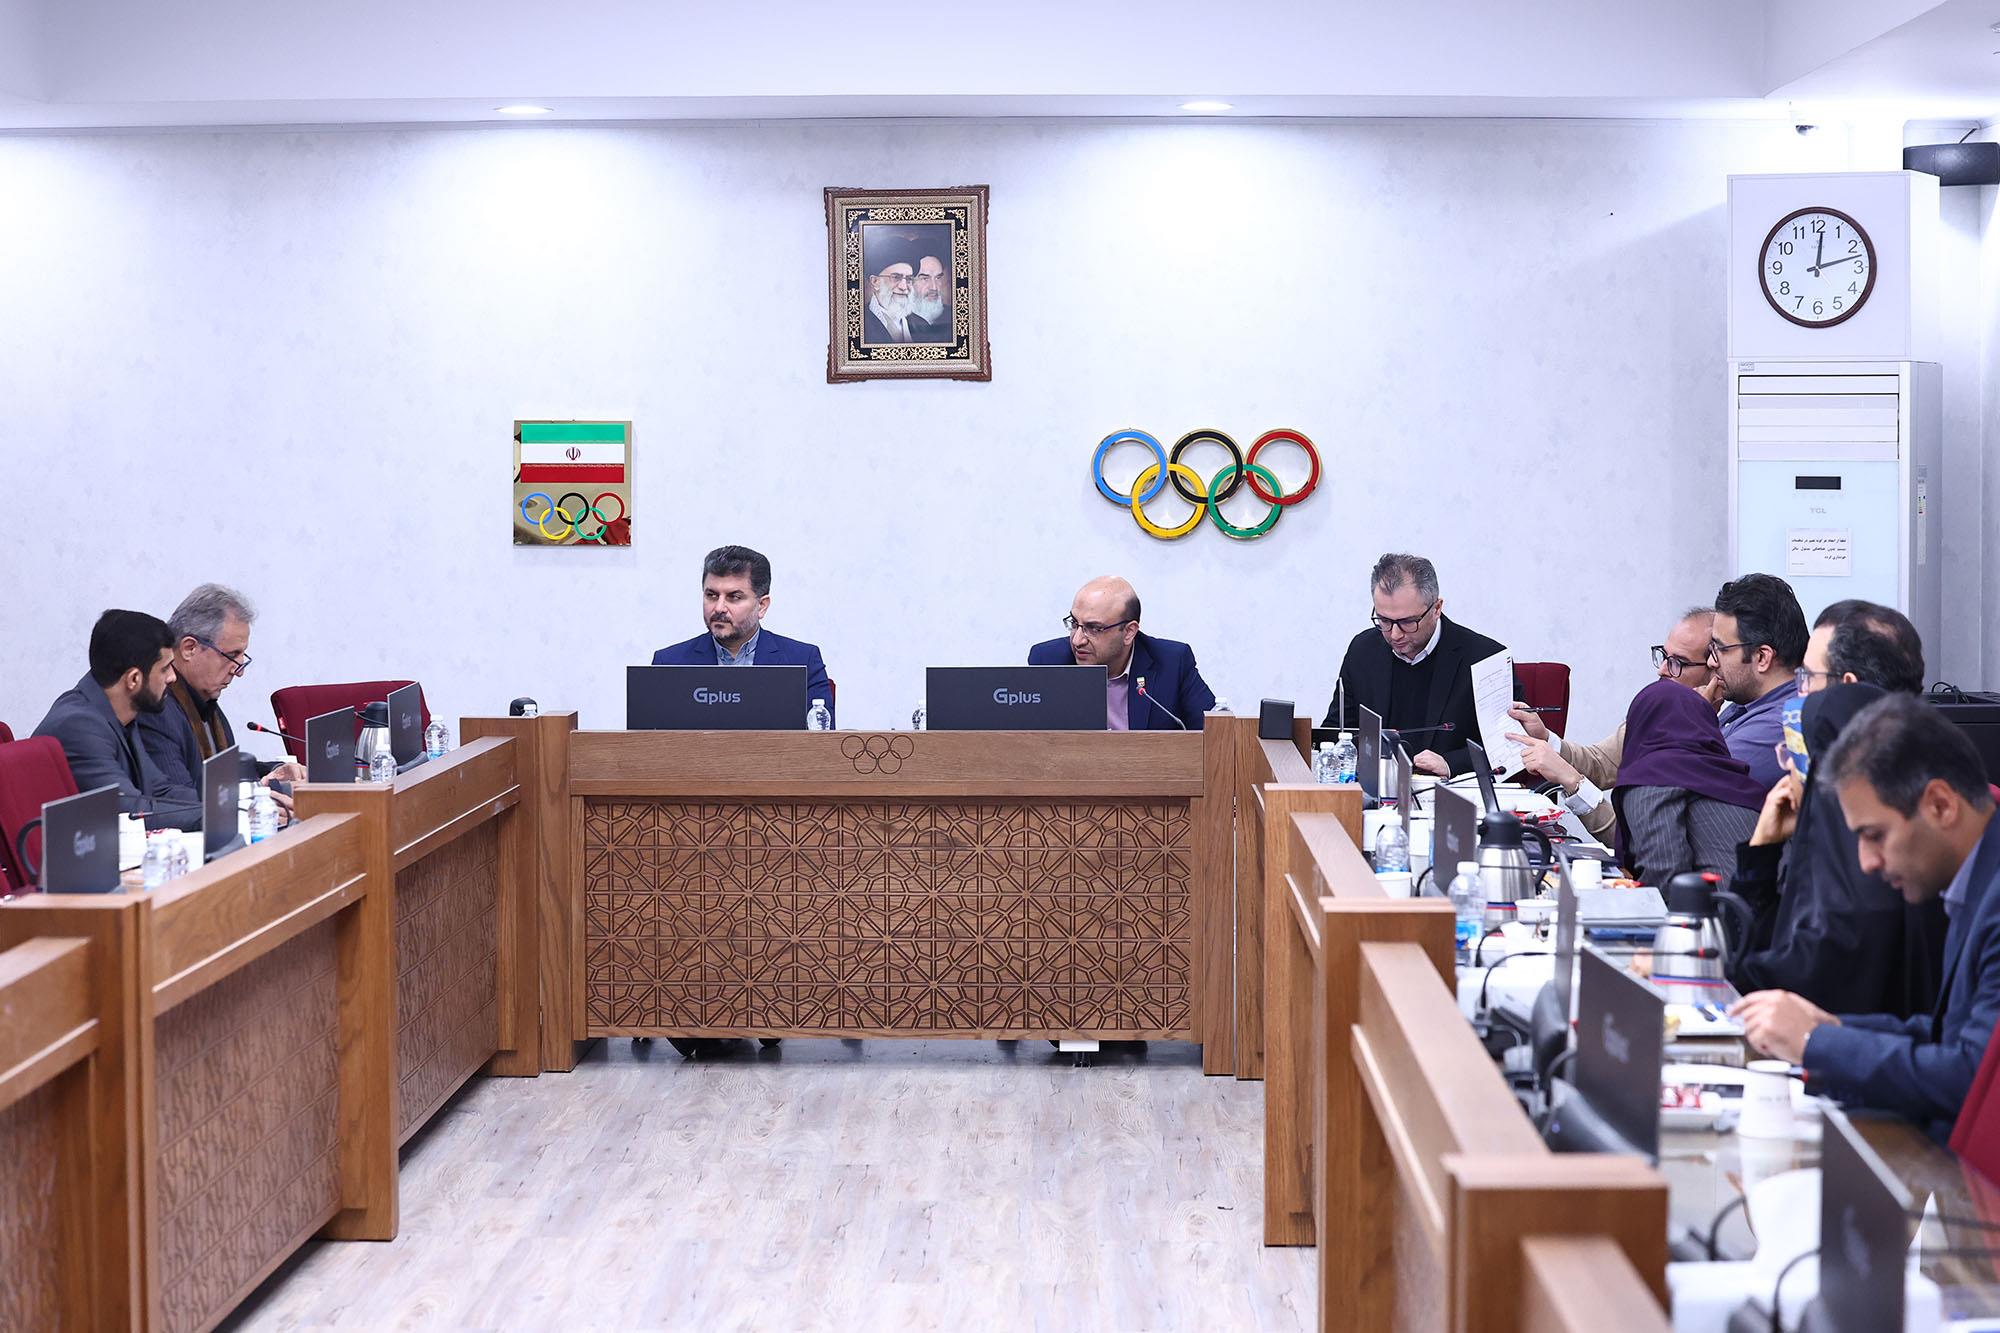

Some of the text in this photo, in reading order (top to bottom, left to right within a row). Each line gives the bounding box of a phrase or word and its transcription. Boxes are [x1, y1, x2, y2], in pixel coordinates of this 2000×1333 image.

[1792, 226, 1805, 239] 11
[1810, 220, 1826, 234] 12
[1836, 225, 1841, 239] 1
[1777, 242, 1793, 255] 10
[1848, 239, 1858, 254] 2
[1772, 261, 1783, 275] 9
[1853, 260, 1864, 274] 3
[1780, 281, 1790, 295] 8
[1847, 281, 1858, 295] 4
[1794, 295, 1804, 309] 7
[1813, 301, 1823, 315] 6
[1832, 297, 1843, 310] 5
[693, 687, 741, 705] Gplus
[993, 687, 1041, 706] Gplus
